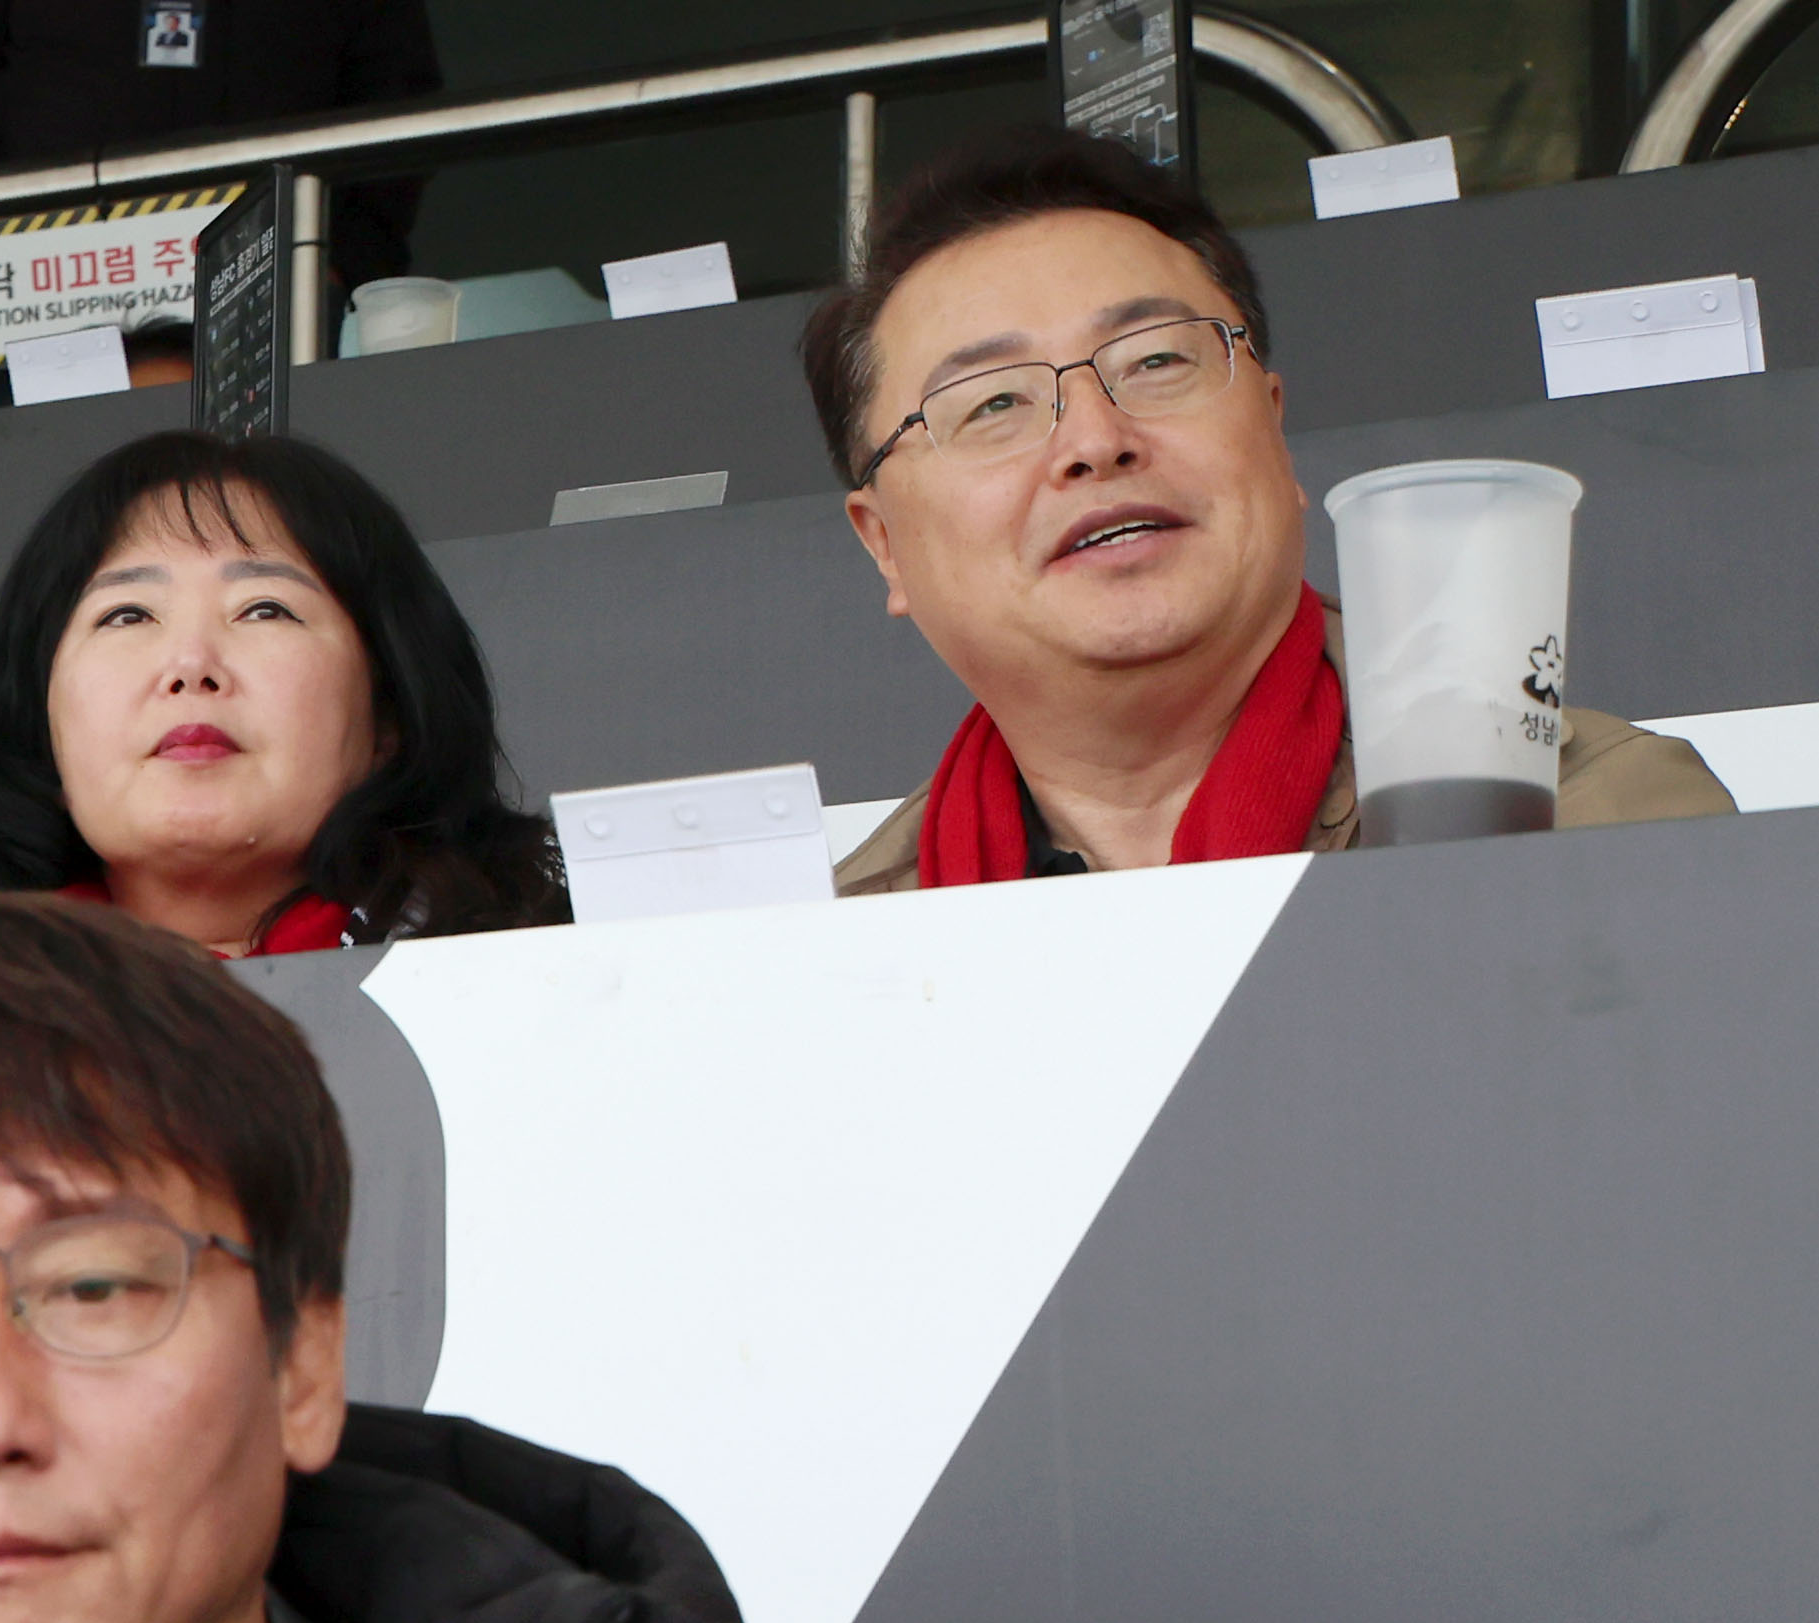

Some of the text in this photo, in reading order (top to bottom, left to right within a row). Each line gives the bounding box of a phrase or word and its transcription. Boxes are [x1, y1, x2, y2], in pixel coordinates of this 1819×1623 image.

[30, 245, 136, 293] 미끄럼
[45, 289, 137, 320] SLIPPING
[1519, 712, 1556, 746] 성남
